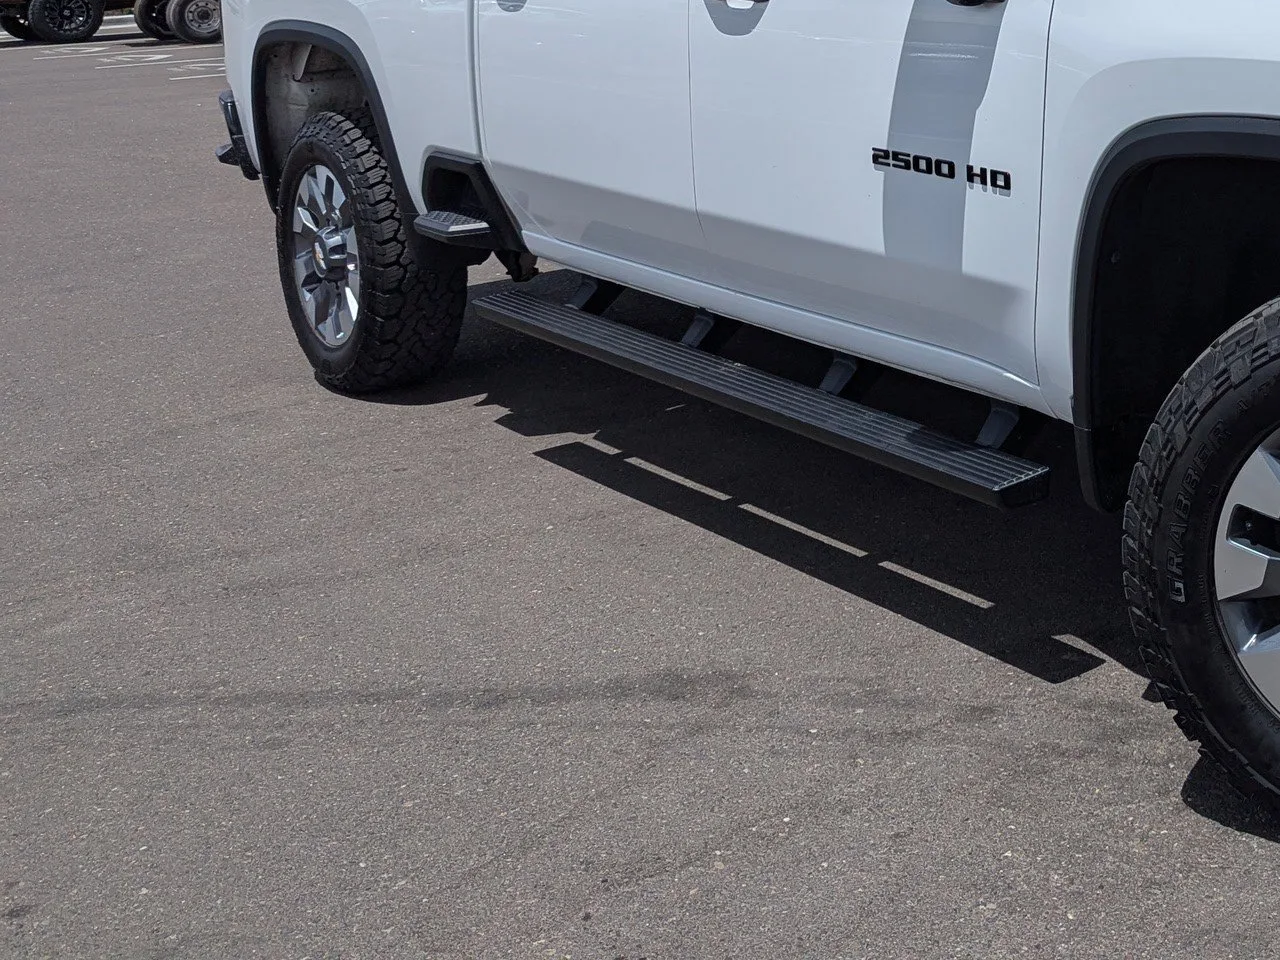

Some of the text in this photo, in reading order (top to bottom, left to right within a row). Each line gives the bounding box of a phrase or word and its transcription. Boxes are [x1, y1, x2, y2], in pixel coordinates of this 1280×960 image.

[872, 147, 1012, 191] 2500 HD
[1167, 419, 1232, 603] GRABBER
